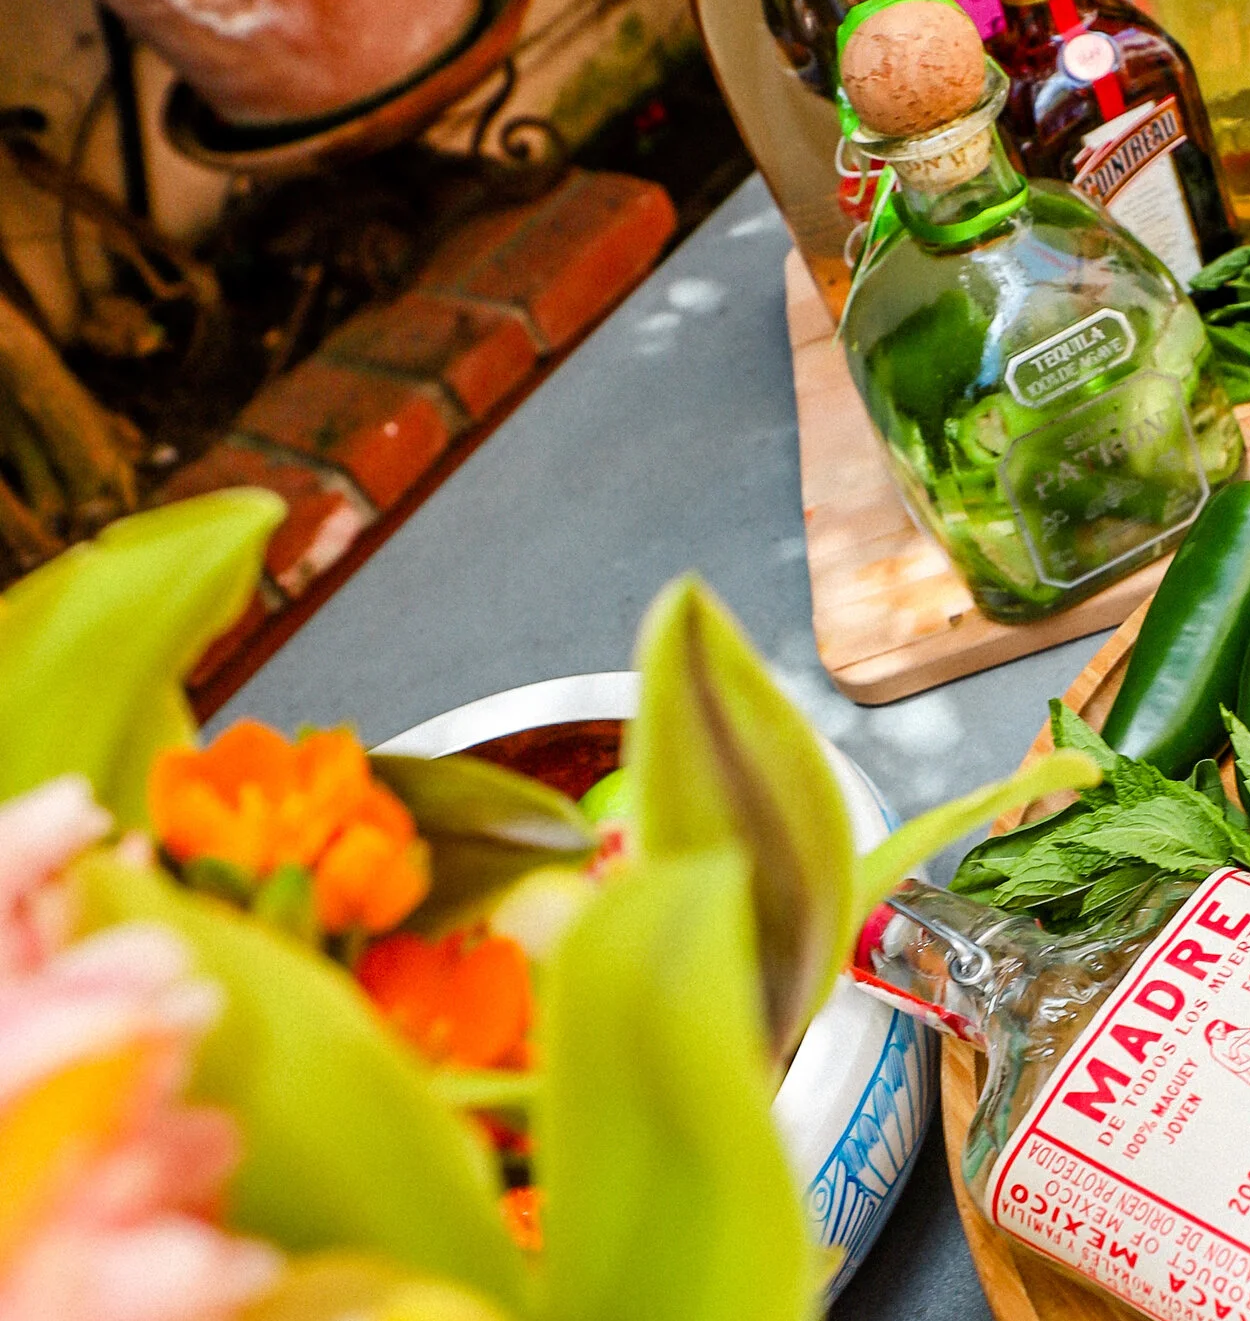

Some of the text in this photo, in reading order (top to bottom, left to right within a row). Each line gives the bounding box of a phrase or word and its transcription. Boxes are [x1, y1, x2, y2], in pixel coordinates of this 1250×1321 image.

[1082, 110, 1178, 197] COINTREAU
[1029, 325, 1107, 374] TEQUILA
[1076, 335, 1125, 370] AGAVE
[1097, 1115, 1126, 1147] DE
[1121, 1040, 1177, 1107] TODOS
[1175, 998, 1209, 1036] LOS
[1122, 1058, 1199, 1160] 100% MAGUEY
[1162, 1093, 1203, 1144] JOVEN
[1027, 1140, 1119, 1204] PROTEGIDA
[1002, 1200, 1062, 1245] FAMILIA
[1010, 1184, 1138, 1269] MEXICO
[1045, 1180, 1124, 1234] MEXICO
[1115, 1192, 1176, 1236] ORIGEN
[1130, 1231, 1159, 1254] OF
[1175, 1225, 1204, 1252] DE
[1081, 1247, 1154, 1296] MORALES
